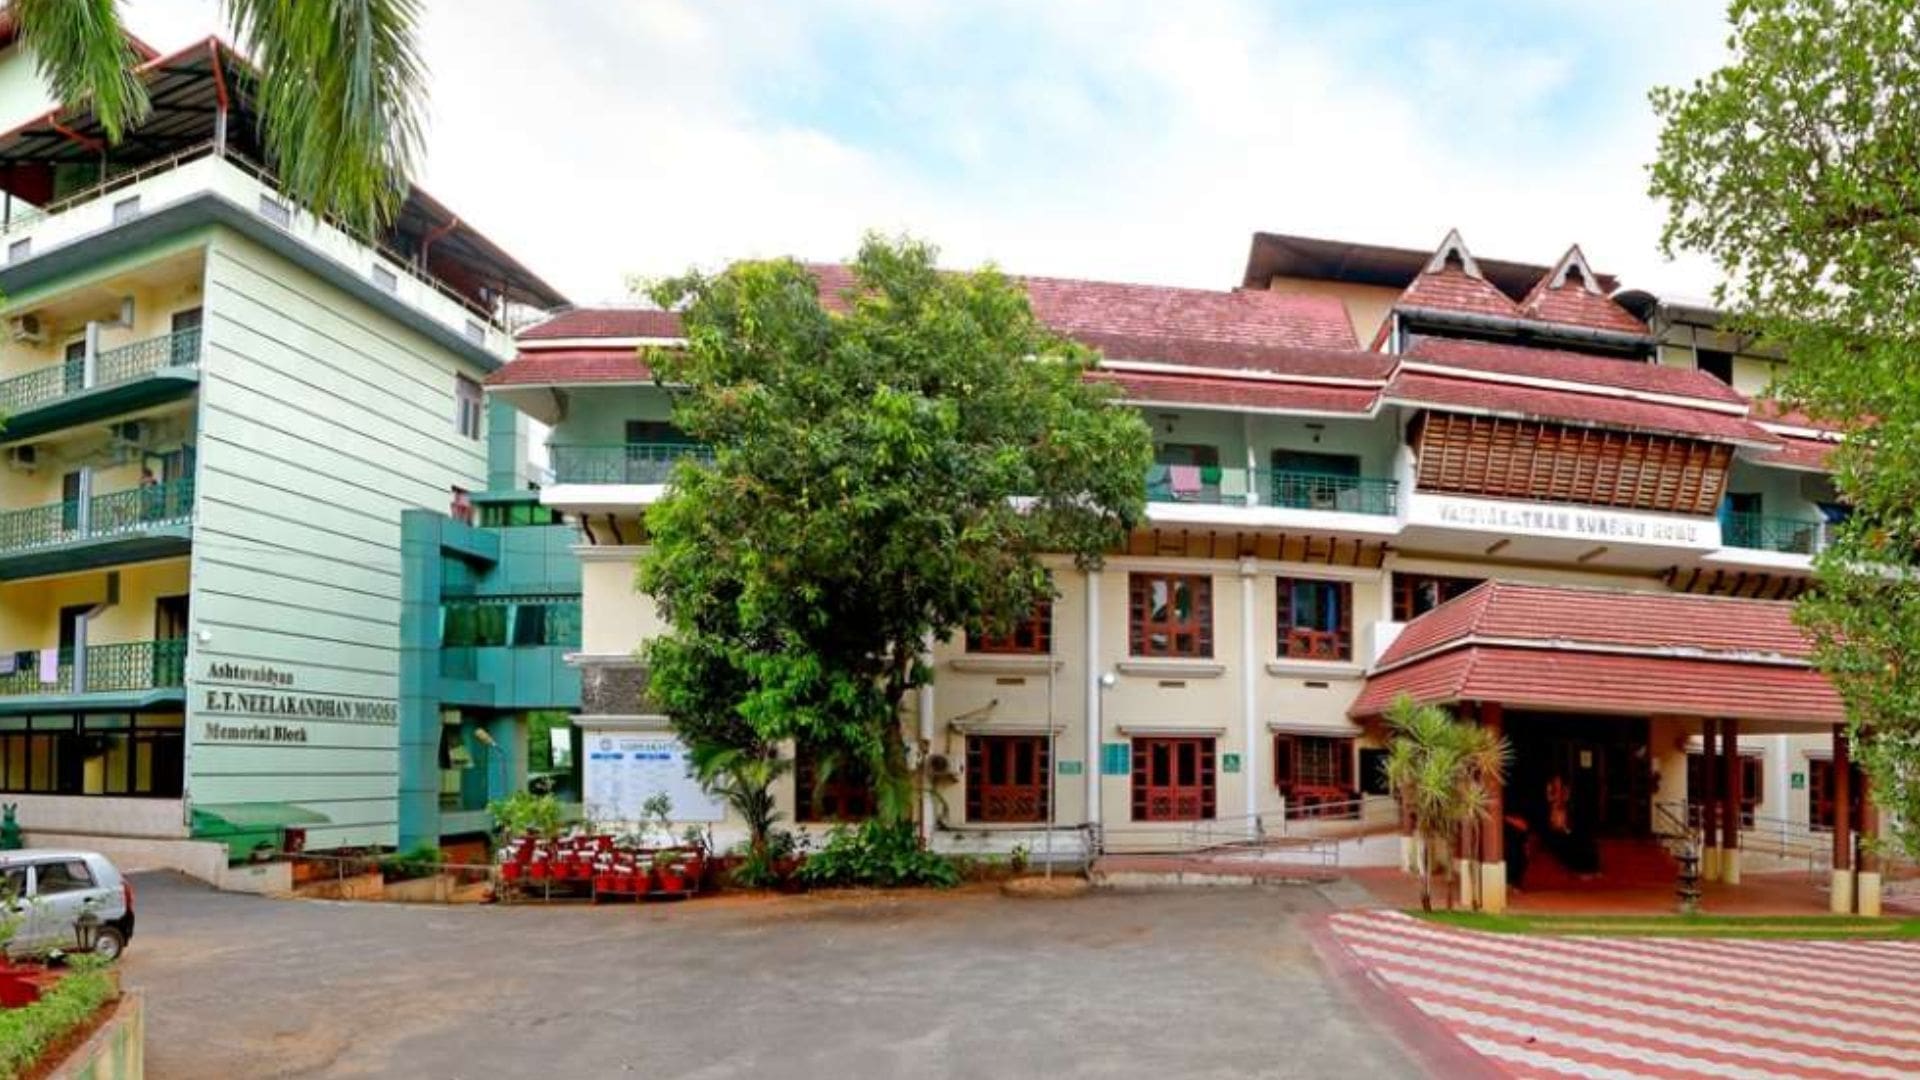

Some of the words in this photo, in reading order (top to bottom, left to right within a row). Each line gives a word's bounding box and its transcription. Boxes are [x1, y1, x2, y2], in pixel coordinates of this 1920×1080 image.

[354, 701, 398, 721] MOOSS
[205, 722, 271, 741] Memorial
[273, 723, 308, 742] Block
